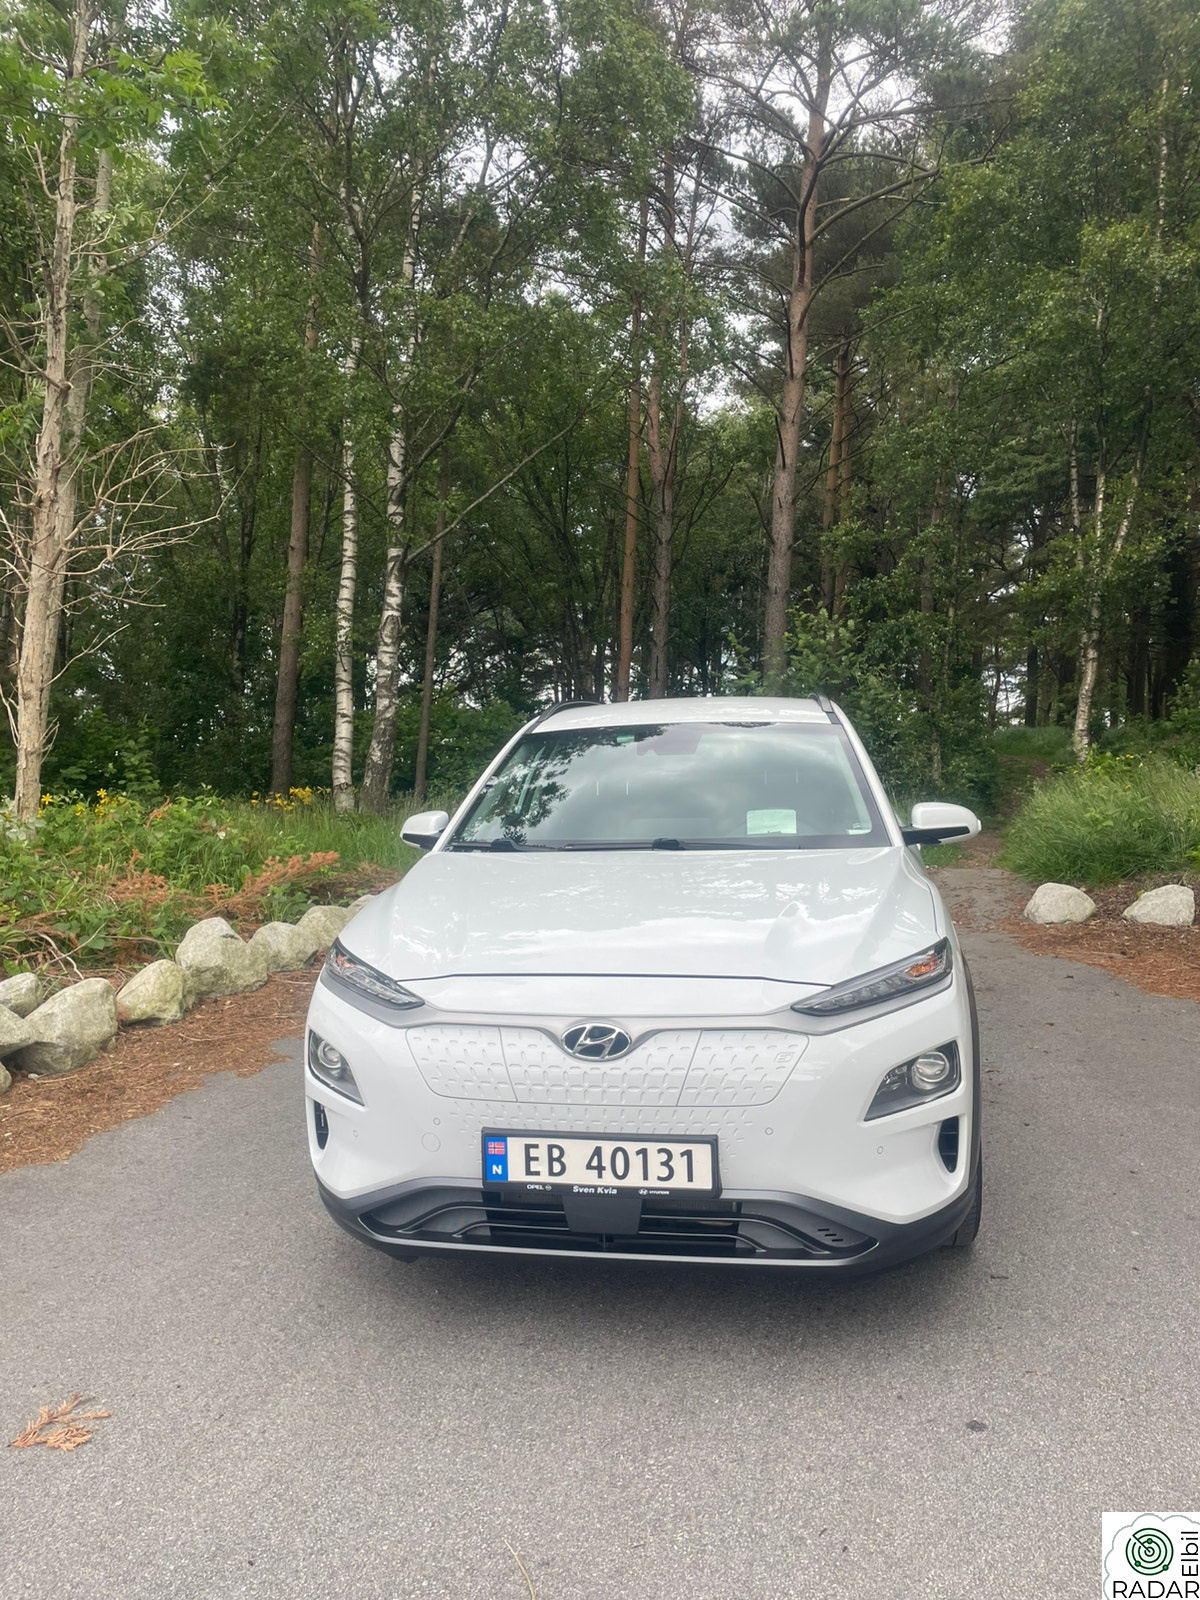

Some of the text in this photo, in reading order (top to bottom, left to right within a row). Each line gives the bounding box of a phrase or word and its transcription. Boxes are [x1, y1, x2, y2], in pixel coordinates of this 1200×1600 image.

[524, 1143, 693, 1183] EB 40131
[492, 1164, 502, 1175] N
[572, 1185, 618, 1195] Sven Kvia
